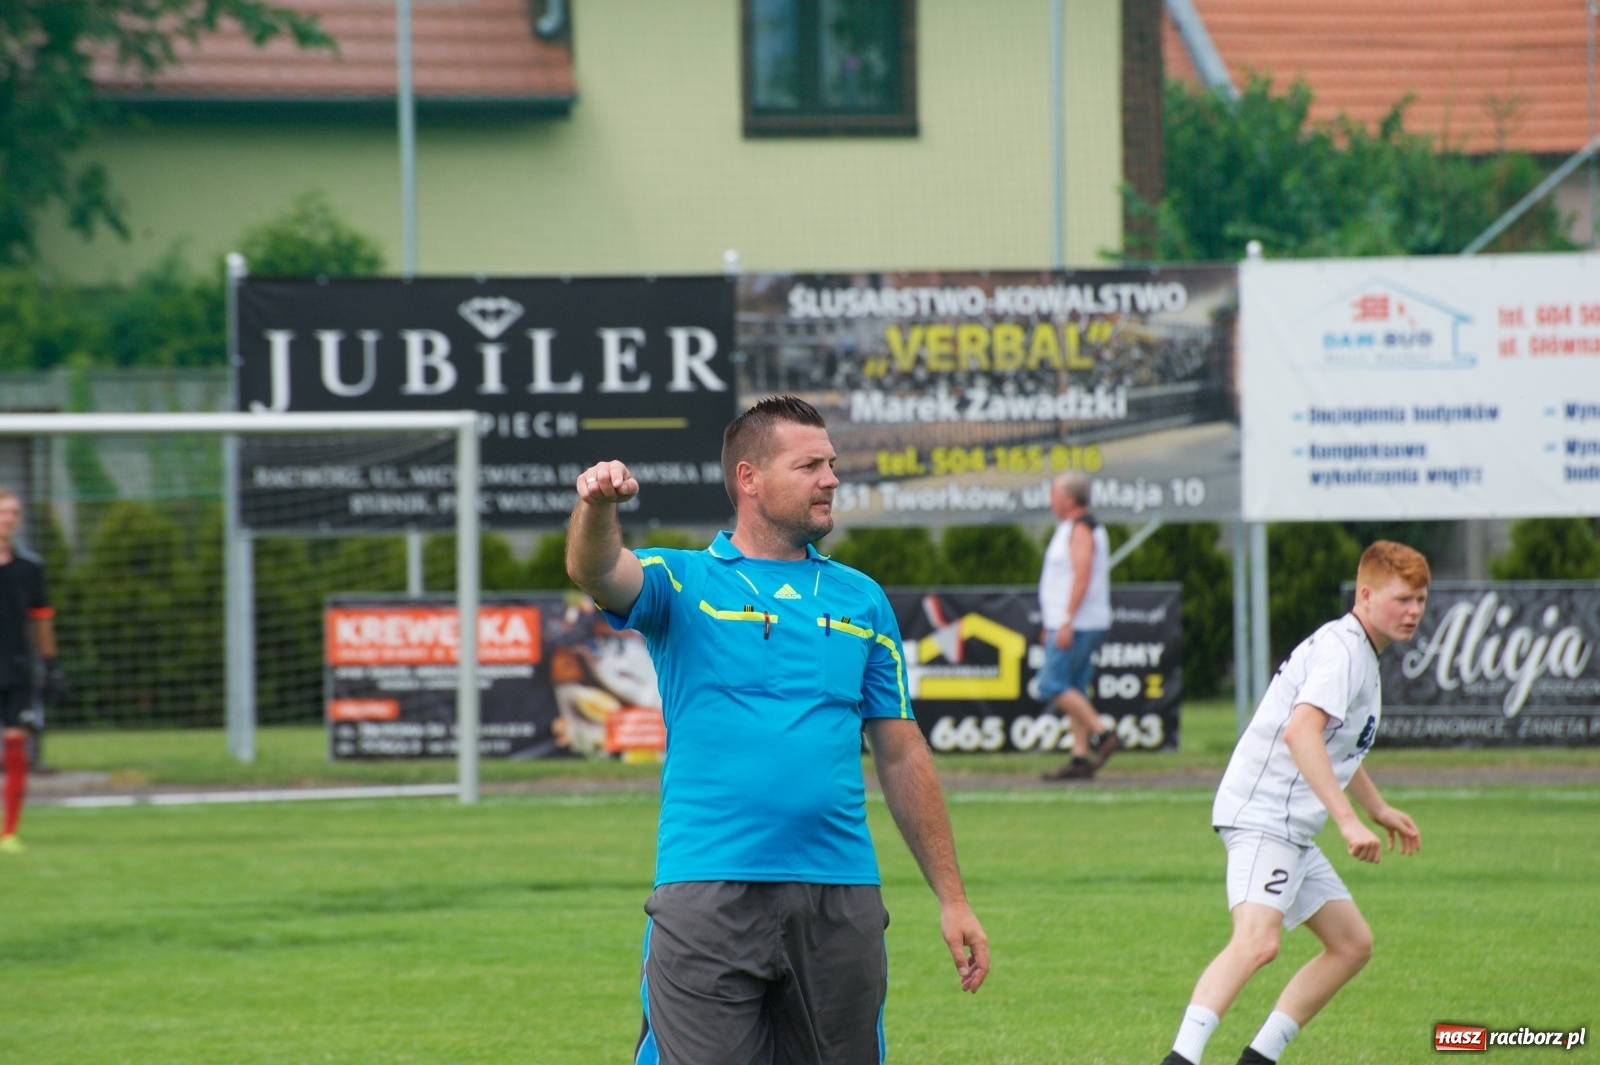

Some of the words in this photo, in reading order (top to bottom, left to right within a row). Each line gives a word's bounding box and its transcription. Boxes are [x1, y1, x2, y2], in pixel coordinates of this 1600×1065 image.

[788, 283, 1187, 318] ŚLUSARSTWO-KOWALSTWO
[851, 388, 958, 424] Marek
[931, 447, 986, 475] 504
[1090, 476, 1164, 513] Maja
[1169, 475, 1206, 507] 10
[335, 613, 531, 646] KREWEKA
[1402, 591, 1594, 718] Alicja
[929, 715, 1004, 751] 665
[1264, 869, 1289, 895] 2
